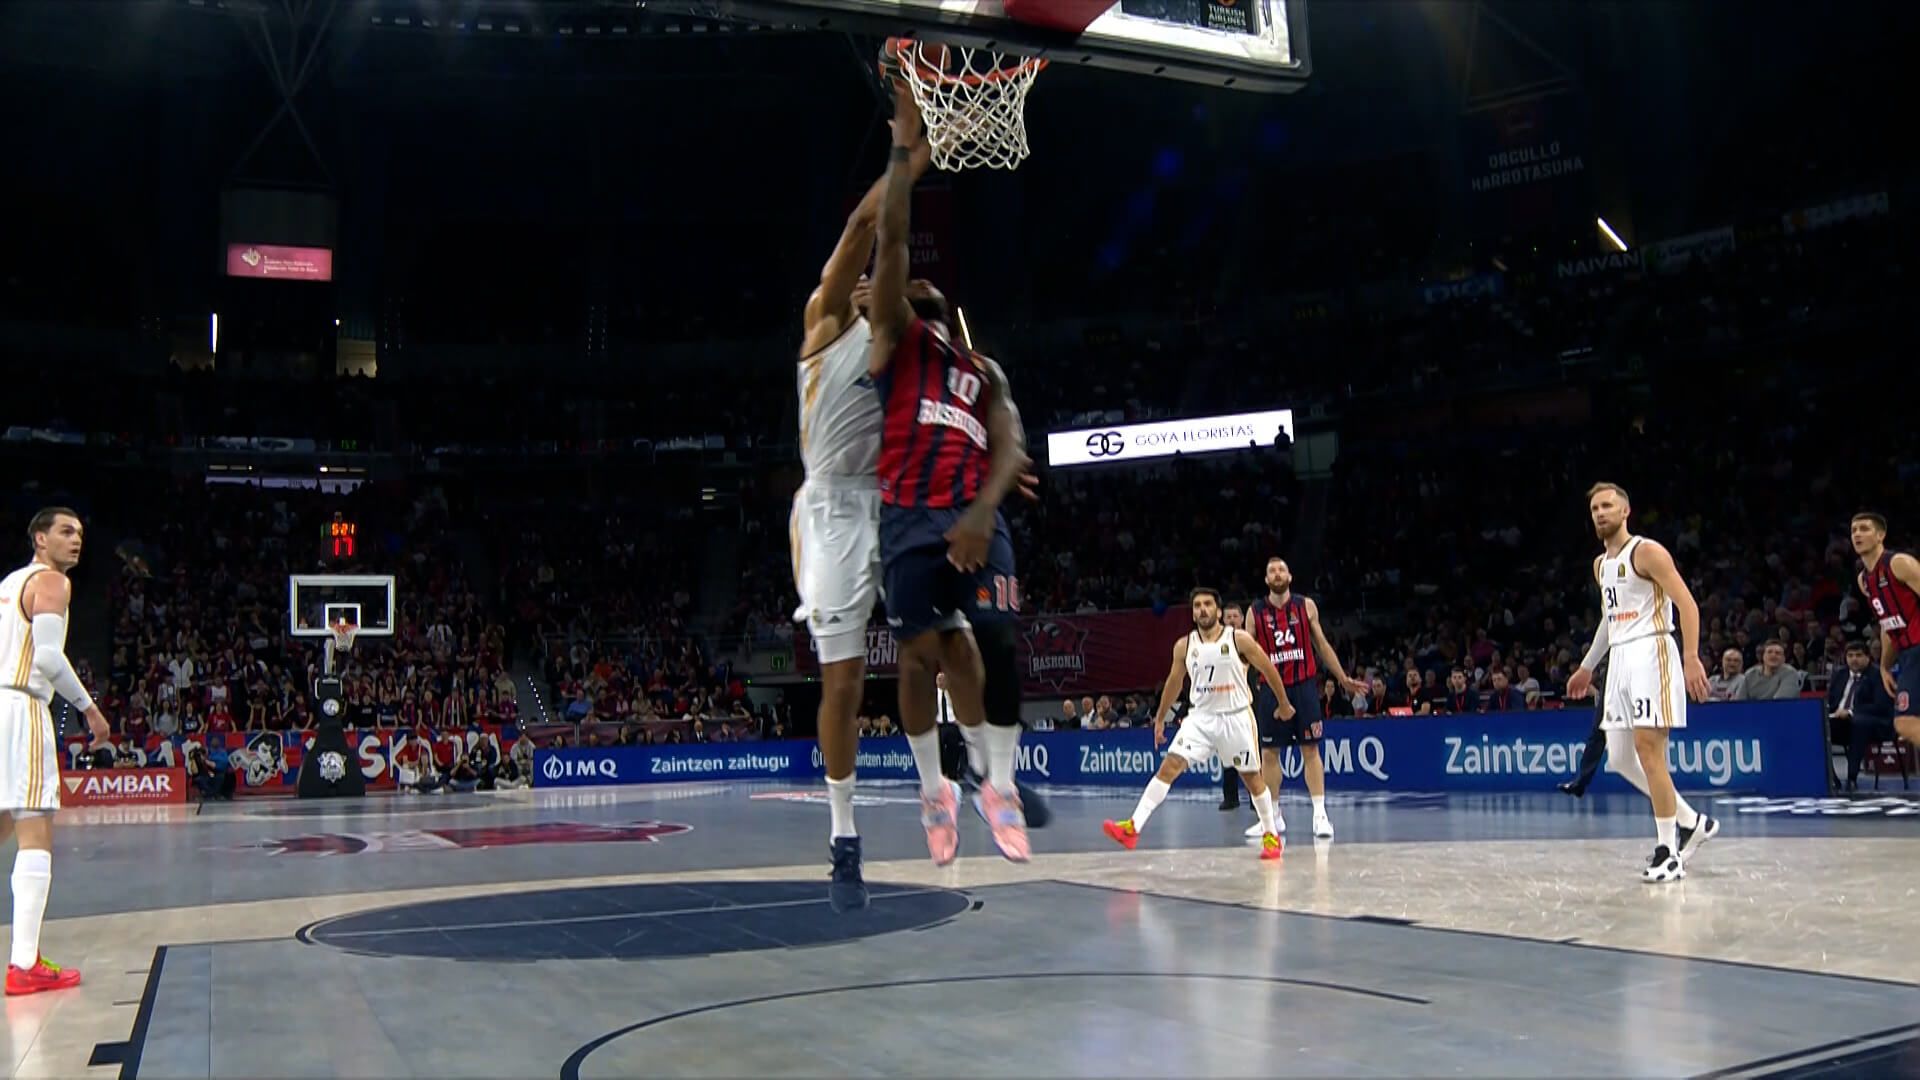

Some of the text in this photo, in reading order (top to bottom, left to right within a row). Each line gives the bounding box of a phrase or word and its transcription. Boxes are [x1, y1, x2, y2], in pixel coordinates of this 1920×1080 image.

[1208, 4, 1245, 19] TURKISH
[1208, 13, 1247, 26] AIRLINES
[1488, 140, 1561, 168] ORGULLO
[1472, 156, 1584, 192] HARROTASUNA
[946, 366, 981, 406] 10
[1135, 433, 1178, 447] GOYA
[1184, 424, 1254, 442] FLORISTAS
[334, 537, 353, 557] 17
[1605, 586, 1618, 609] 31
[1872, 597, 1884, 616] 9
[1274, 629, 1295, 646] 24
[1205, 665, 1215, 682] 7
[1633, 697, 1651, 720] 31
[566, 758, 618, 778] IMQ
[651, 753, 789, 774] Zaintzen zaitugu
[855, 749, 913, 772] aintzen zaitugu
[1015, 744, 1051, 778] MQ
[1079, 744, 1155, 774] Zaintzen
[1239, 751, 1249, 766] 7
[1323, 736, 1390, 780] MQ
[1444, 734, 1763, 785] Zaintzen tugu
[84, 774, 173, 795] AMBAR
